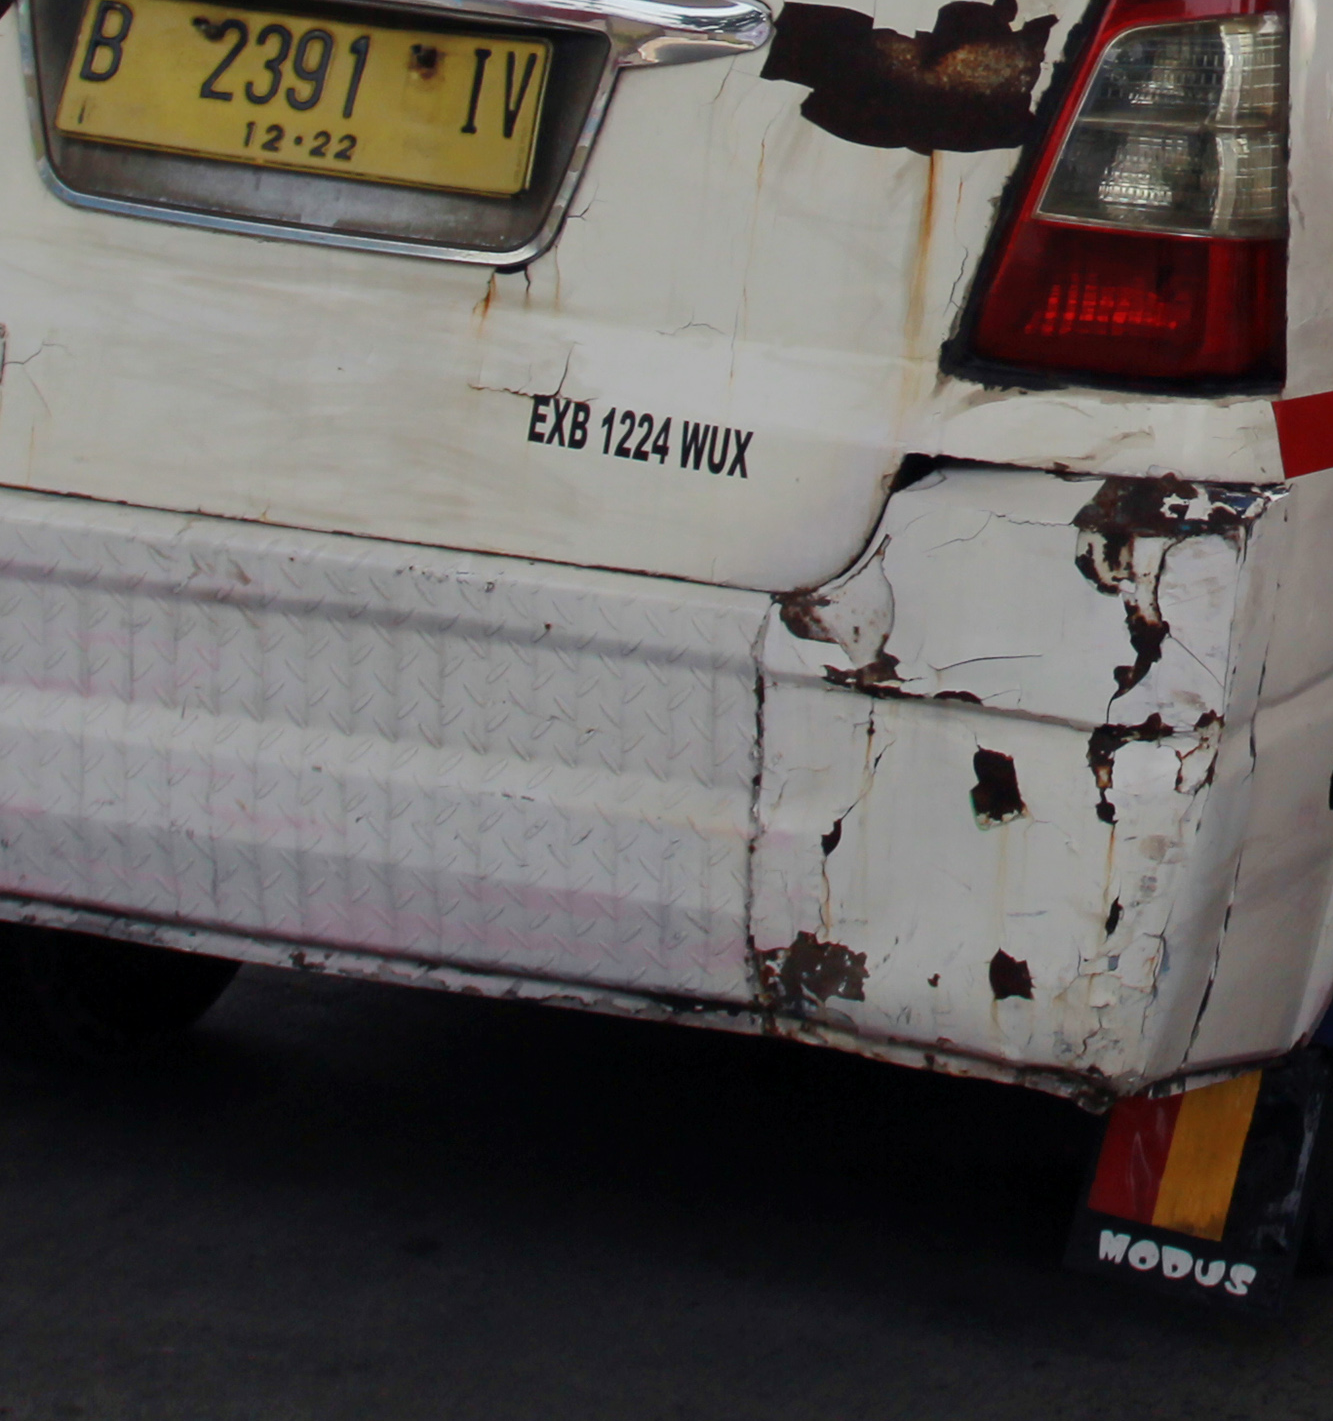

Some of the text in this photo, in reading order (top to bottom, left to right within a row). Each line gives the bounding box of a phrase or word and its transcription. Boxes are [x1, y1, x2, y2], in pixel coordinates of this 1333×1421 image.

[79, 0, 538, 138] B 2391 IV
[527, 394, 754, 478] EXB 1224 WUX
[1098, 1229, 1257, 1296] MODUS
